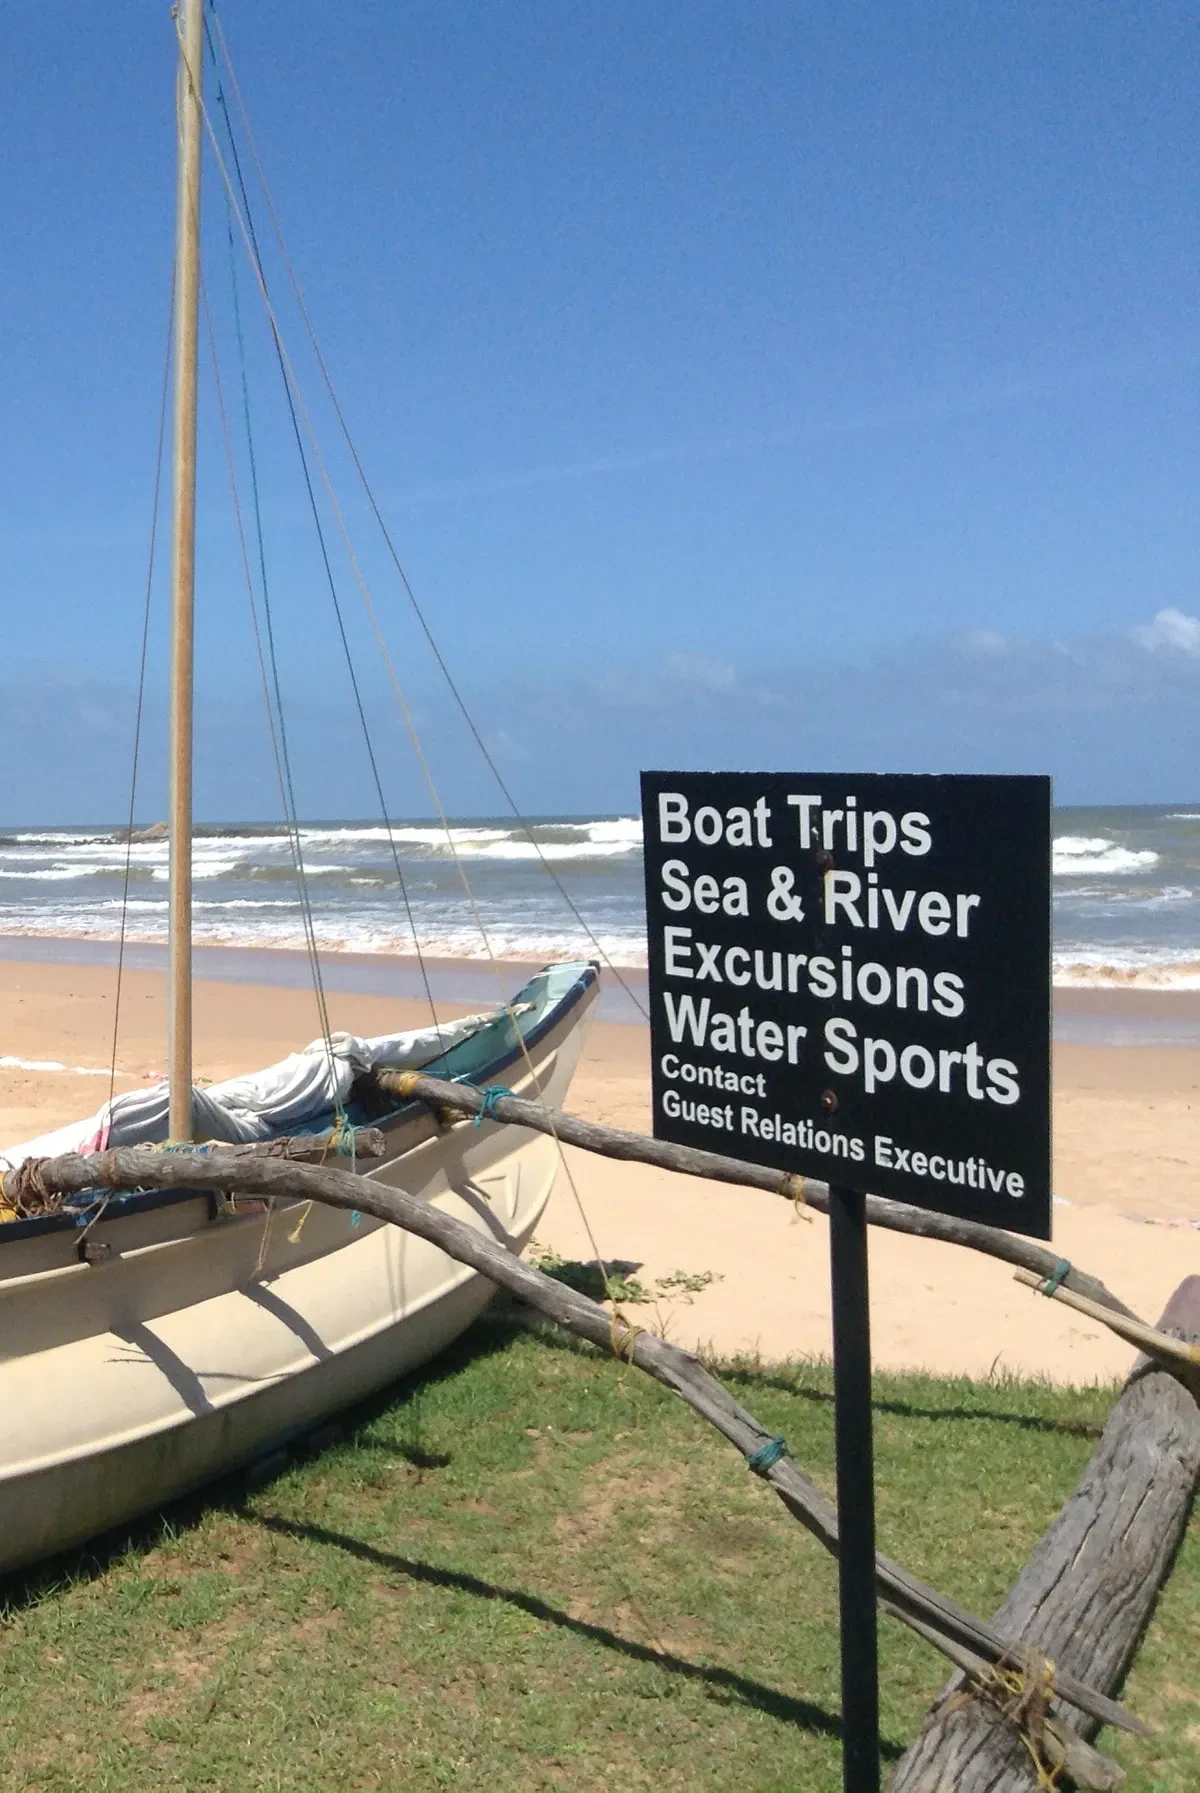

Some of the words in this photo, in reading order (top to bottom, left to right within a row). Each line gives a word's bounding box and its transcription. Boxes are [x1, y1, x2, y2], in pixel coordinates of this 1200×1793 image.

[659, 793, 772, 848] Boat
[787, 795, 932, 867] Trips
[662, 860, 749, 916] Sea
[767, 866, 805, 922] &
[824, 870, 980, 938] River
[664, 926, 965, 1017] Excursions
[661, 1054, 767, 1098] Contact
[663, 992, 807, 1065] Water
[824, 1018, 1020, 1104] Sports
[663, 1090, 734, 1132] Guest
[740, 1107, 865, 1162] Relations
[874, 1136, 1025, 1198] Executive
